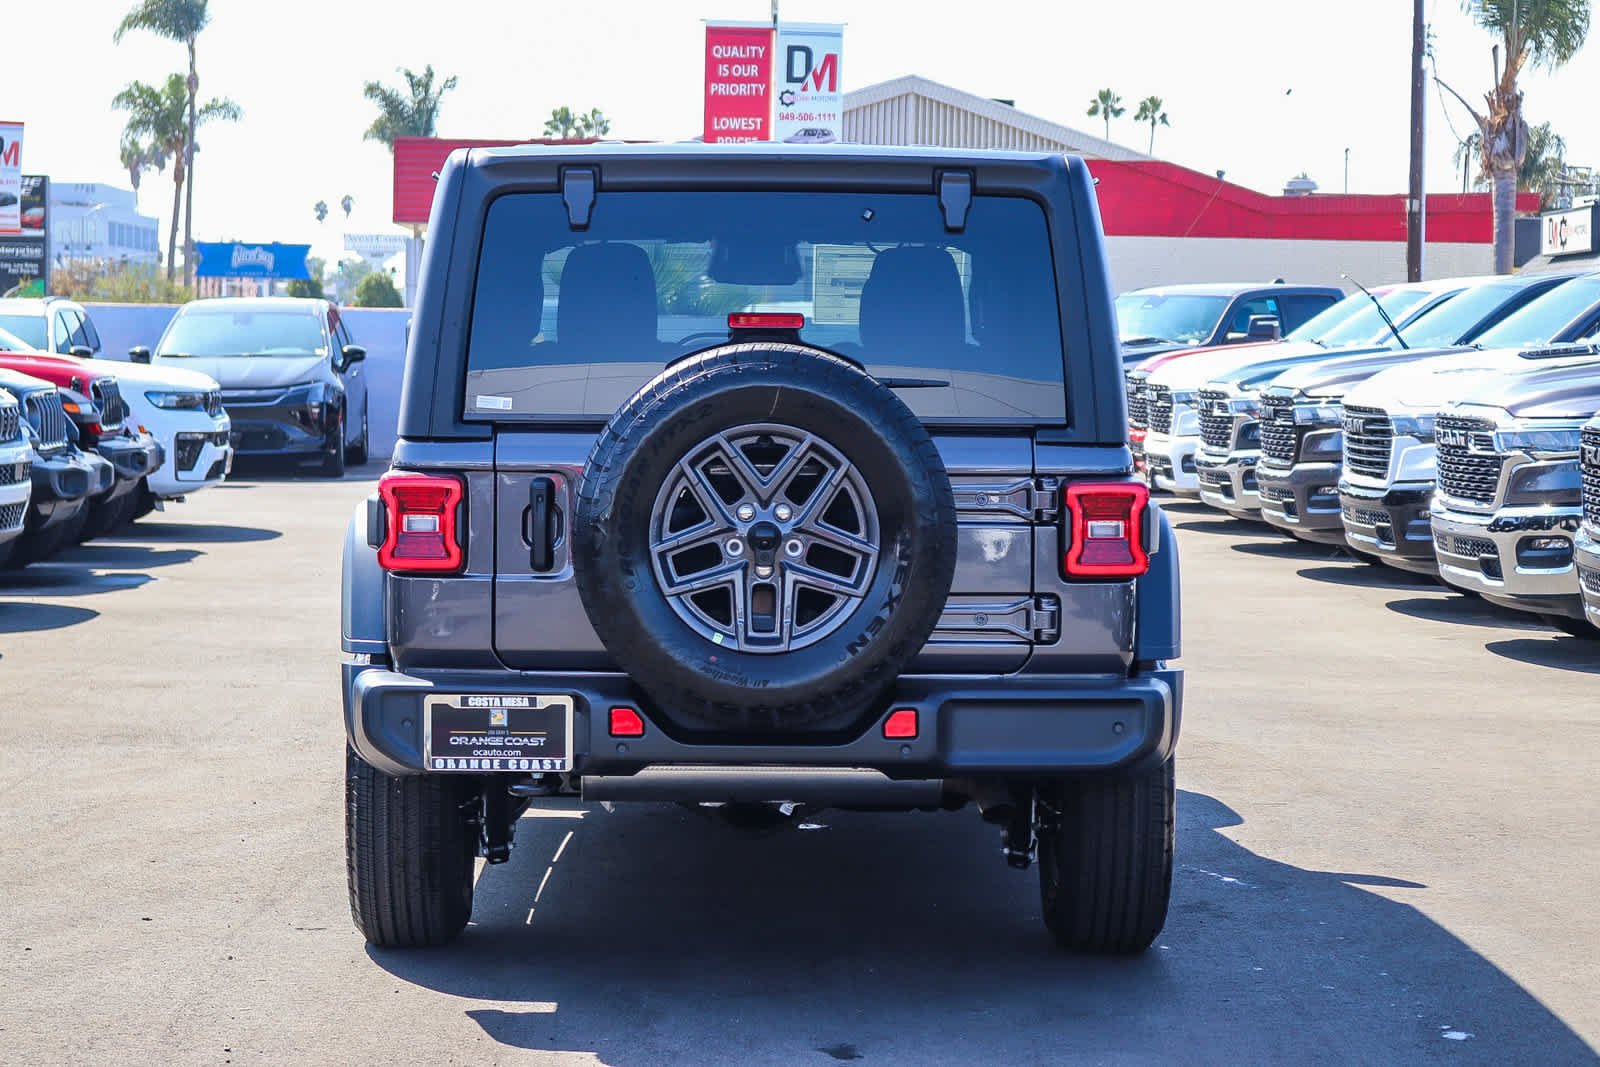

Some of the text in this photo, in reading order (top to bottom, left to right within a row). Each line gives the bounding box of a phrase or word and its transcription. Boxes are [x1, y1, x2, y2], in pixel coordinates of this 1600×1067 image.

[712, 45, 766, 59] QUALITY
[718, 64, 759, 77] IS OUR
[710, 83, 766, 96] PRIORITY
[713, 117, 763, 130] LOWEST
[468, 696, 530, 707] COSTA MESA
[449, 736, 547, 746] ORANGE COAST
[473, 749, 522, 757] ocauto.com
[435, 758, 563, 770] ORANGE COAST
